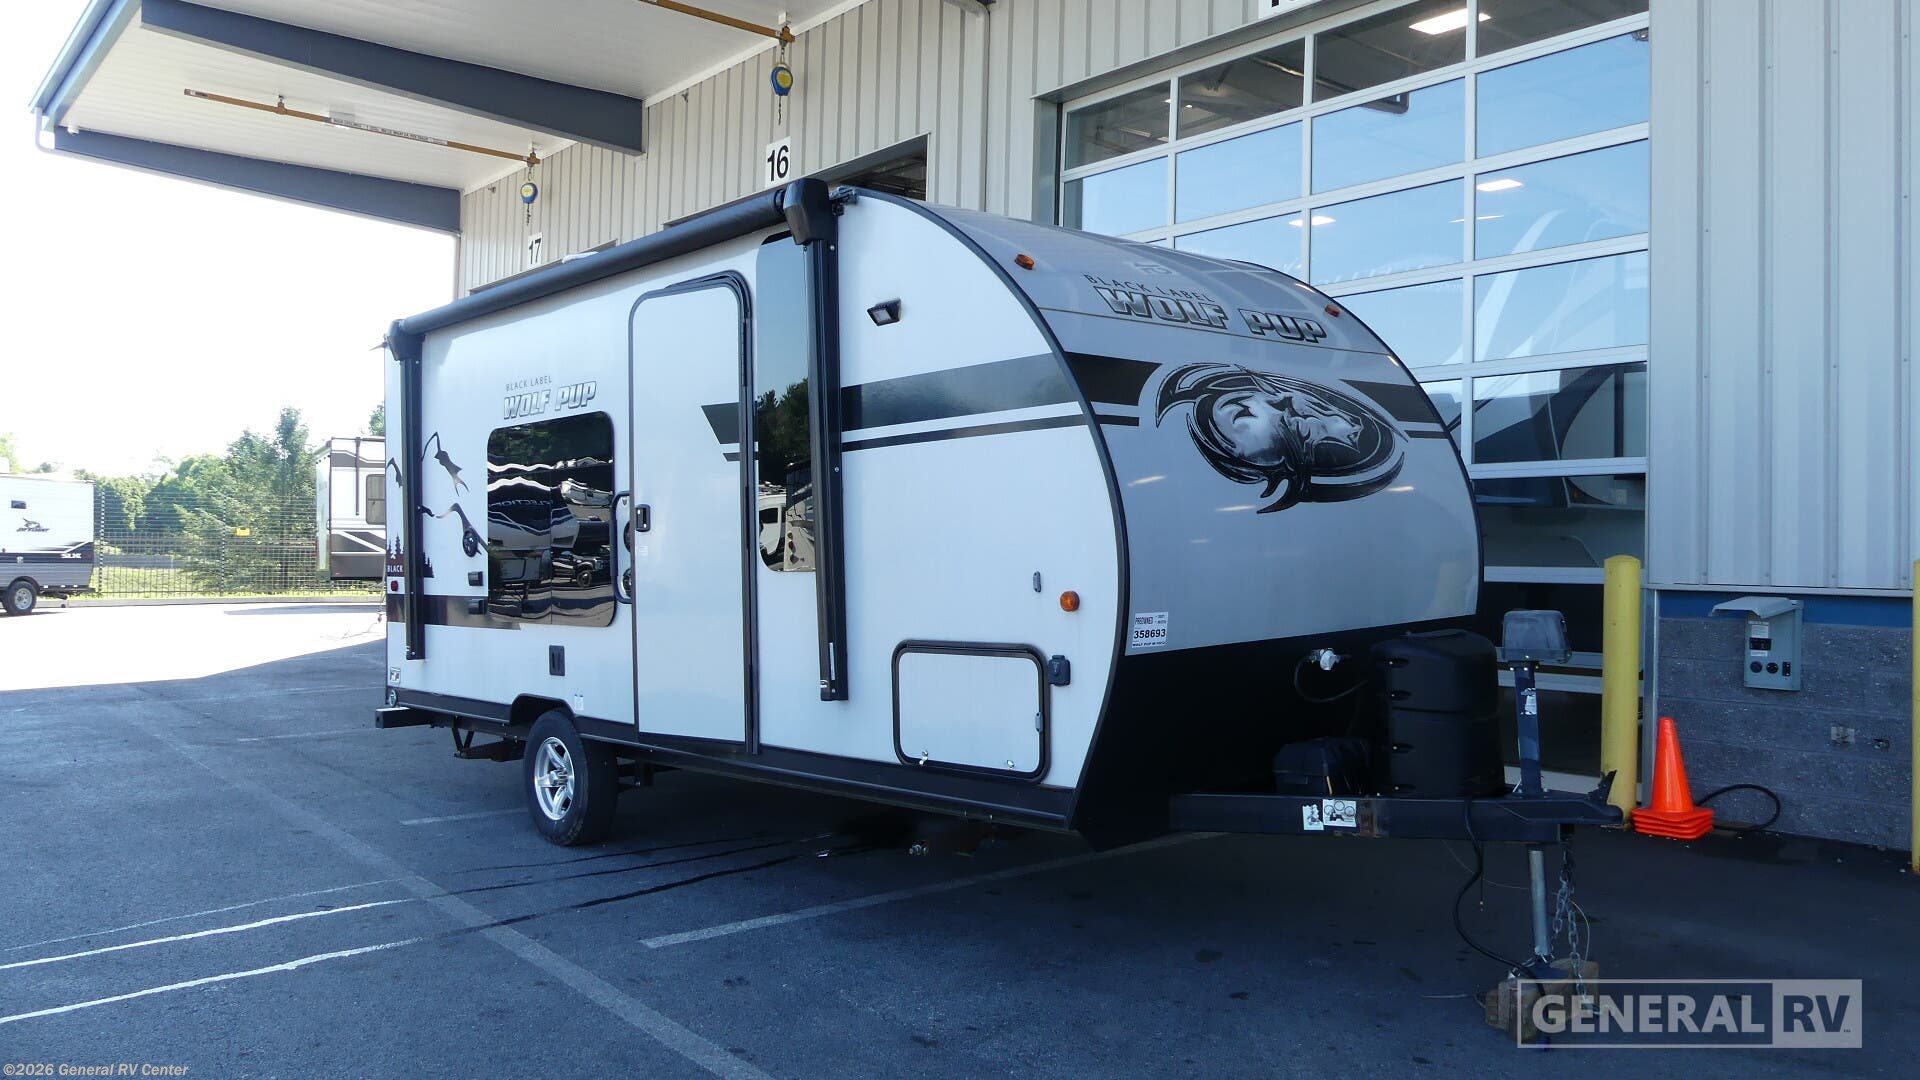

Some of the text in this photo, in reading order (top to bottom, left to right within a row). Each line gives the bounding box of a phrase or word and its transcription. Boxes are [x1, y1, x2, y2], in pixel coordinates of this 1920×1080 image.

[767, 145, 789, 181] 16
[529, 238, 541, 264] 17
[1083, 273, 1216, 303] BLACK LABEL
[1093, 286, 1328, 343] WOLF PUP
[505, 375, 553, 392] BLACK LABEL
[503, 380, 597, 420] WOLF PUP
[387, 564, 404, 573] BLACK
[1133, 629, 1166, 639] 358693
